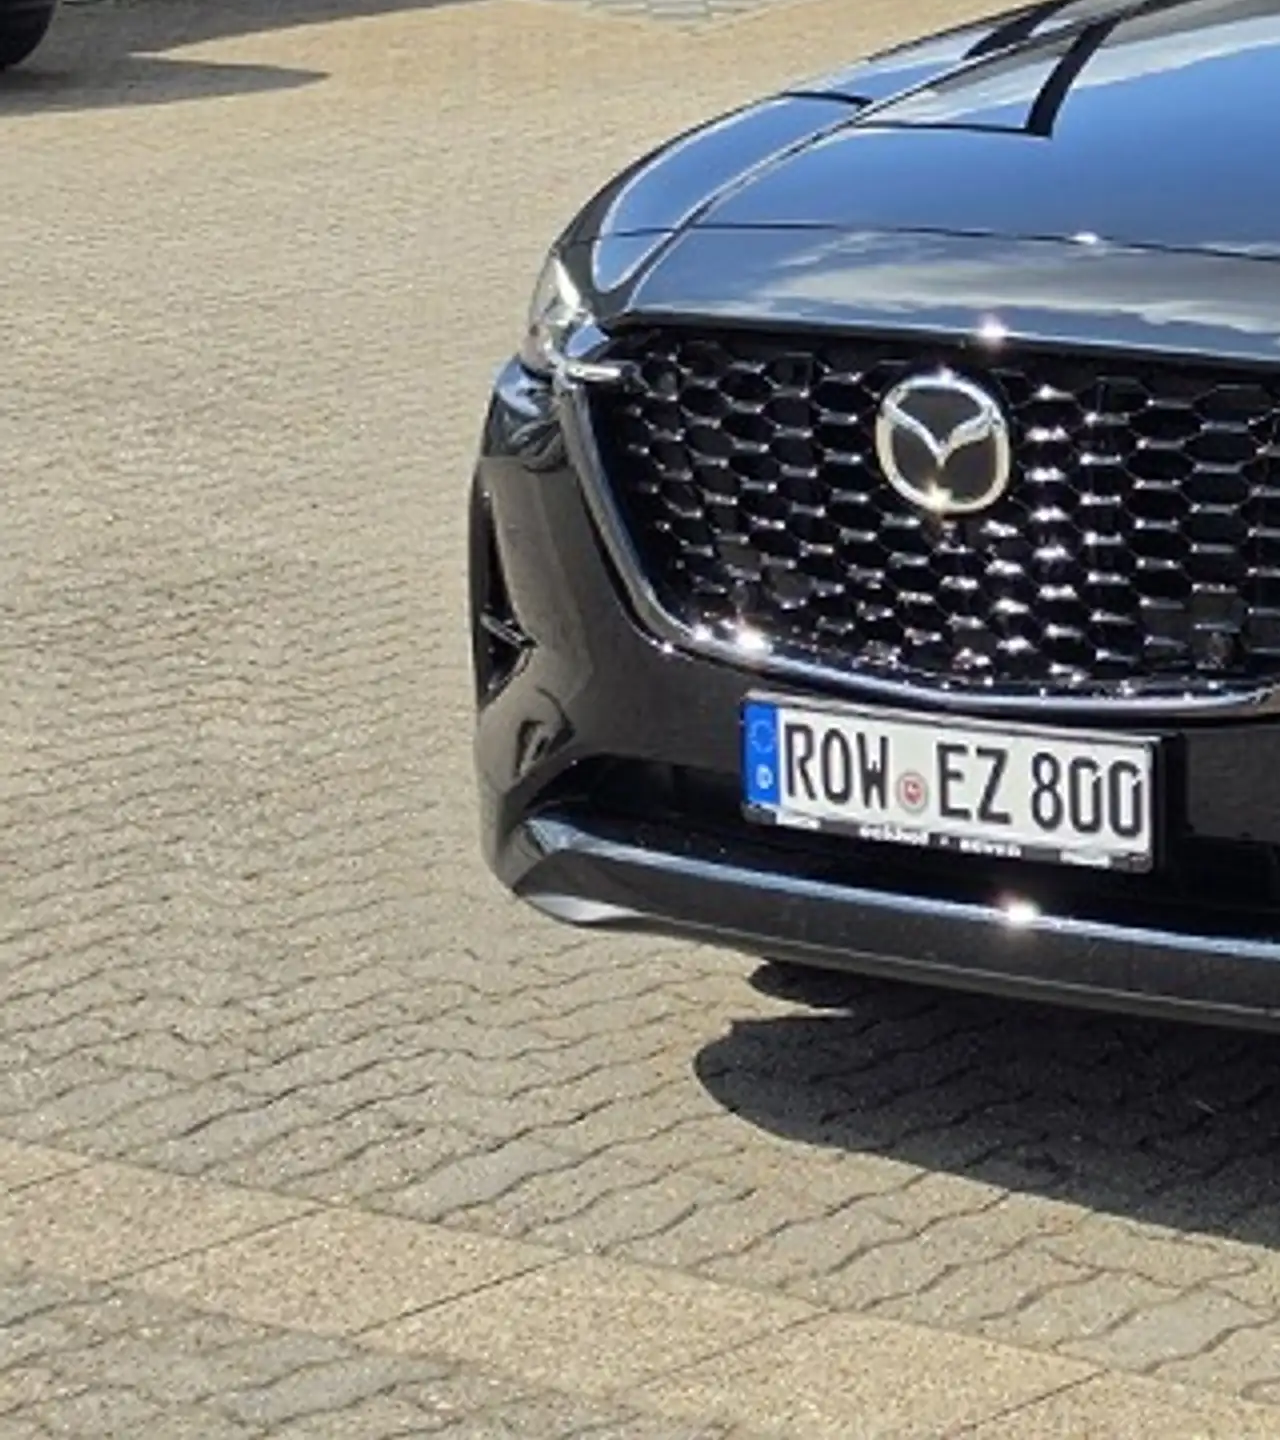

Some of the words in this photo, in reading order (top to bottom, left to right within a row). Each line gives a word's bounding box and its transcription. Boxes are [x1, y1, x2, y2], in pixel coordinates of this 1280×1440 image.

[783, 723, 890, 810] ROW
[936, 742, 1012, 826] EZ
[1030, 751, 1144, 838] 800
